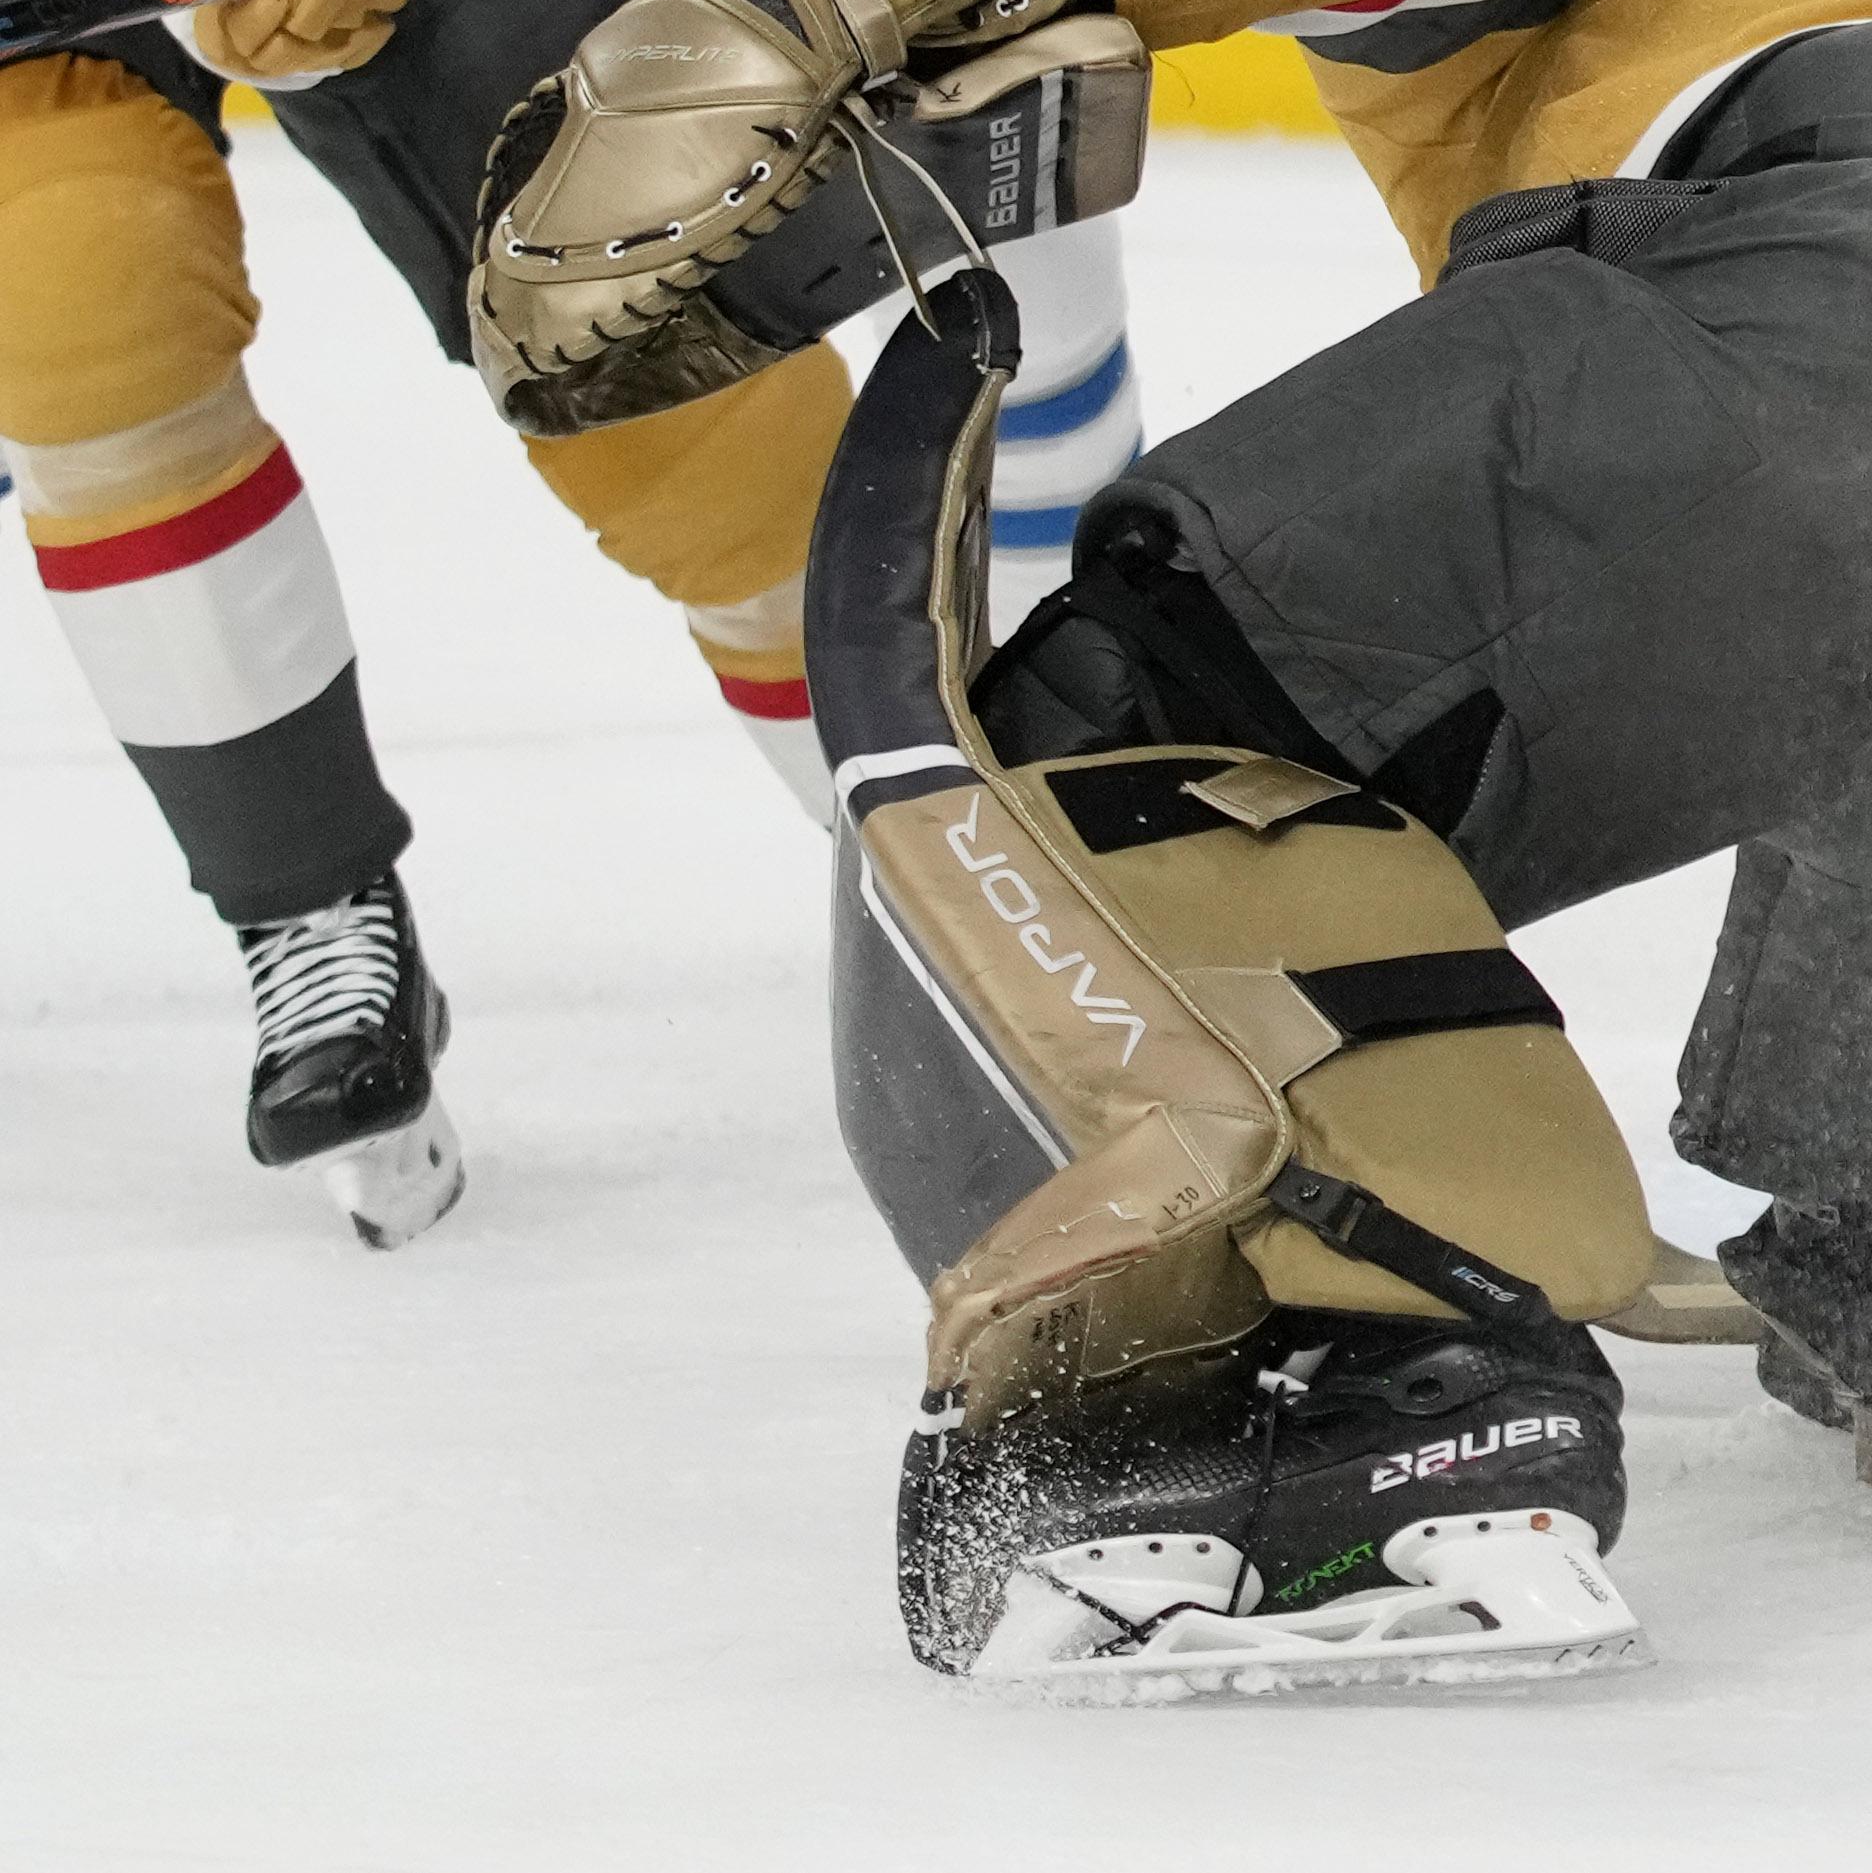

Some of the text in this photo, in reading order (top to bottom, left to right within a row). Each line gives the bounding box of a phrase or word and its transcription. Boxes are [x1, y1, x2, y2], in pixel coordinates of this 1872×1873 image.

[984, 110, 1023, 229] BAUER
[945, 790, 1147, 1069] VAPOR
[1463, 1271, 1521, 1306] CRS
[1369, 1414, 1586, 1495] BAUER
